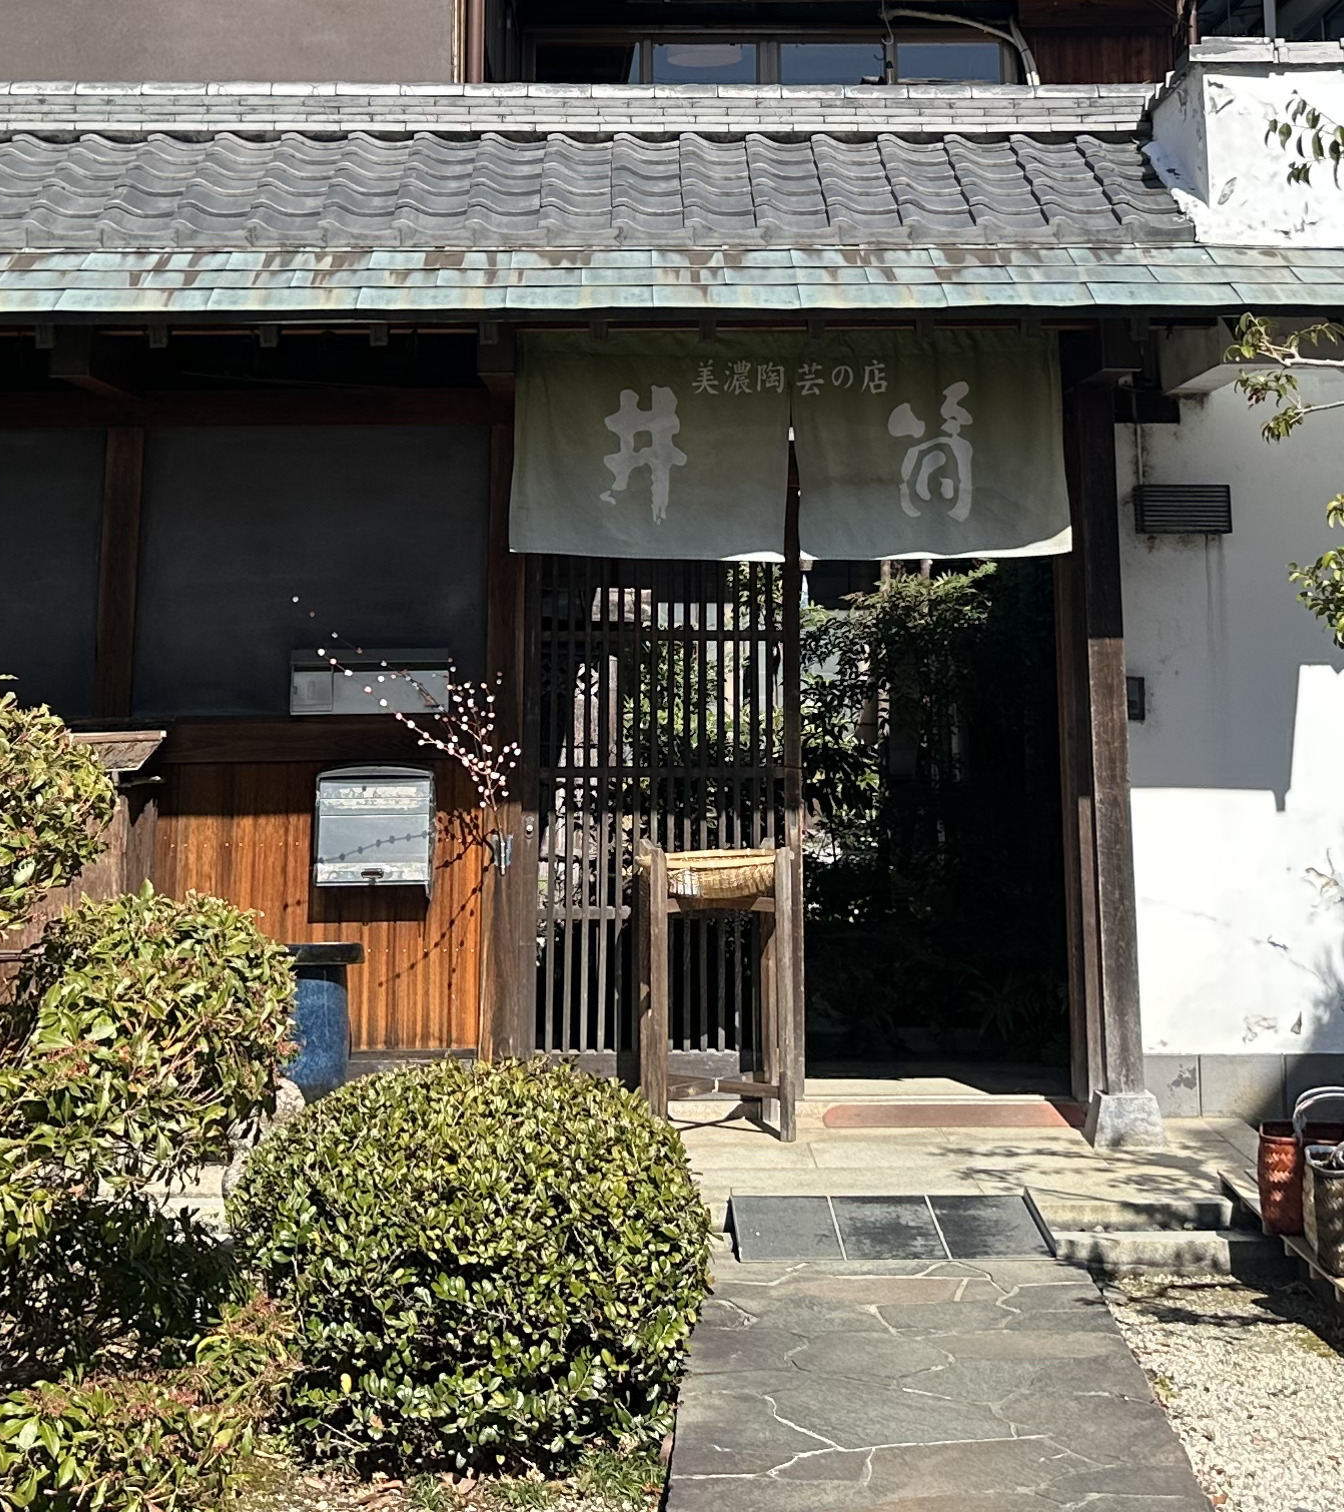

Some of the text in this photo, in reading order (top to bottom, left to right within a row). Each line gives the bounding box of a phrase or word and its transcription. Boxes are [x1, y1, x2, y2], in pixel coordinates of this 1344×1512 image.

[691, 359, 889, 396] 美濃陶芸の店
